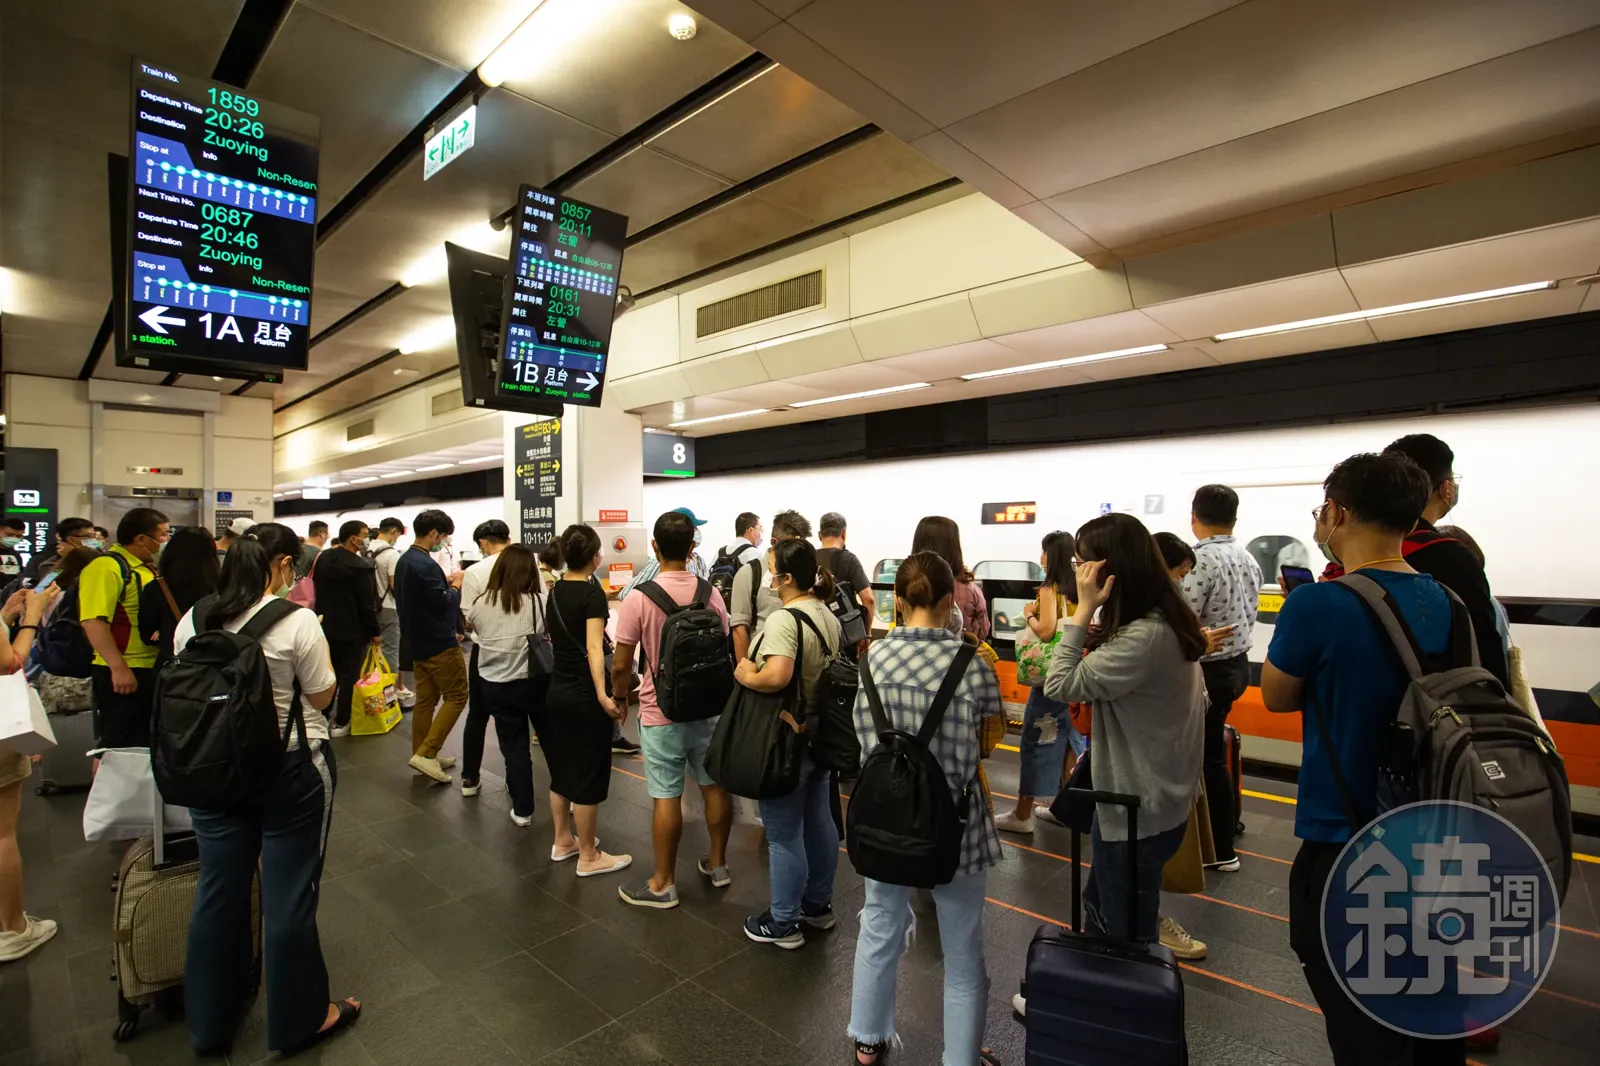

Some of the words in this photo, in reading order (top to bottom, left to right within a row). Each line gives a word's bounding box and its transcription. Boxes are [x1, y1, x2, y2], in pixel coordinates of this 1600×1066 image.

[142, 65, 162, 78] Train
[165, 72, 179, 82] No.
[141, 90, 181, 108] Departure
[183, 102, 203, 114] Time
[208, 88, 259, 116] 1859
[141, 112, 186, 130] Destination
[205, 108, 264, 139] 20:26
[140, 142, 159, 153] Stop
[204, 130, 268, 161] Zuoying
[203, 151, 218, 160] Info
[139, 188, 158, 199] Next
[160, 193, 179, 204] Train
[181, 198, 195, 207] No.
[527, 190, 555, 205] 本班列車
[202, 203, 253, 228] 0687
[525, 206, 553, 221] 開車時間
[562, 202, 592, 220] 0857
[139, 212, 177, 226] Departure
[180, 220, 198, 230] Time
[559, 218, 592, 237] 20:11
[138, 233, 182, 246] Destination
[201, 224, 258, 248] 20:46
[521, 242, 542, 254] 停靠站
[138, 260, 156, 270] Stop
[200, 244, 262, 270] Zuoying
[199, 264, 213, 273] Info
[517, 277, 544, 290] 下班列車
[514, 292, 542, 306] 開車時間
[550, 286, 579, 302] 0161
[548, 301, 580, 317] 20:31
[199, 313, 244, 342] 1A
[547, 316, 567, 329] 左營
[255, 322, 292, 341] 月台
[511, 327, 531, 338] 停靠站
[140, 334, 177, 346] station.
[254, 337, 286, 348] Platform
[513, 362, 539, 383] 1B
[545, 368, 569, 382] 月台
[546, 388, 567, 397] Zuoying
[673, 443, 686, 464] 8
[524, 507, 552, 520] 自由座車廂
